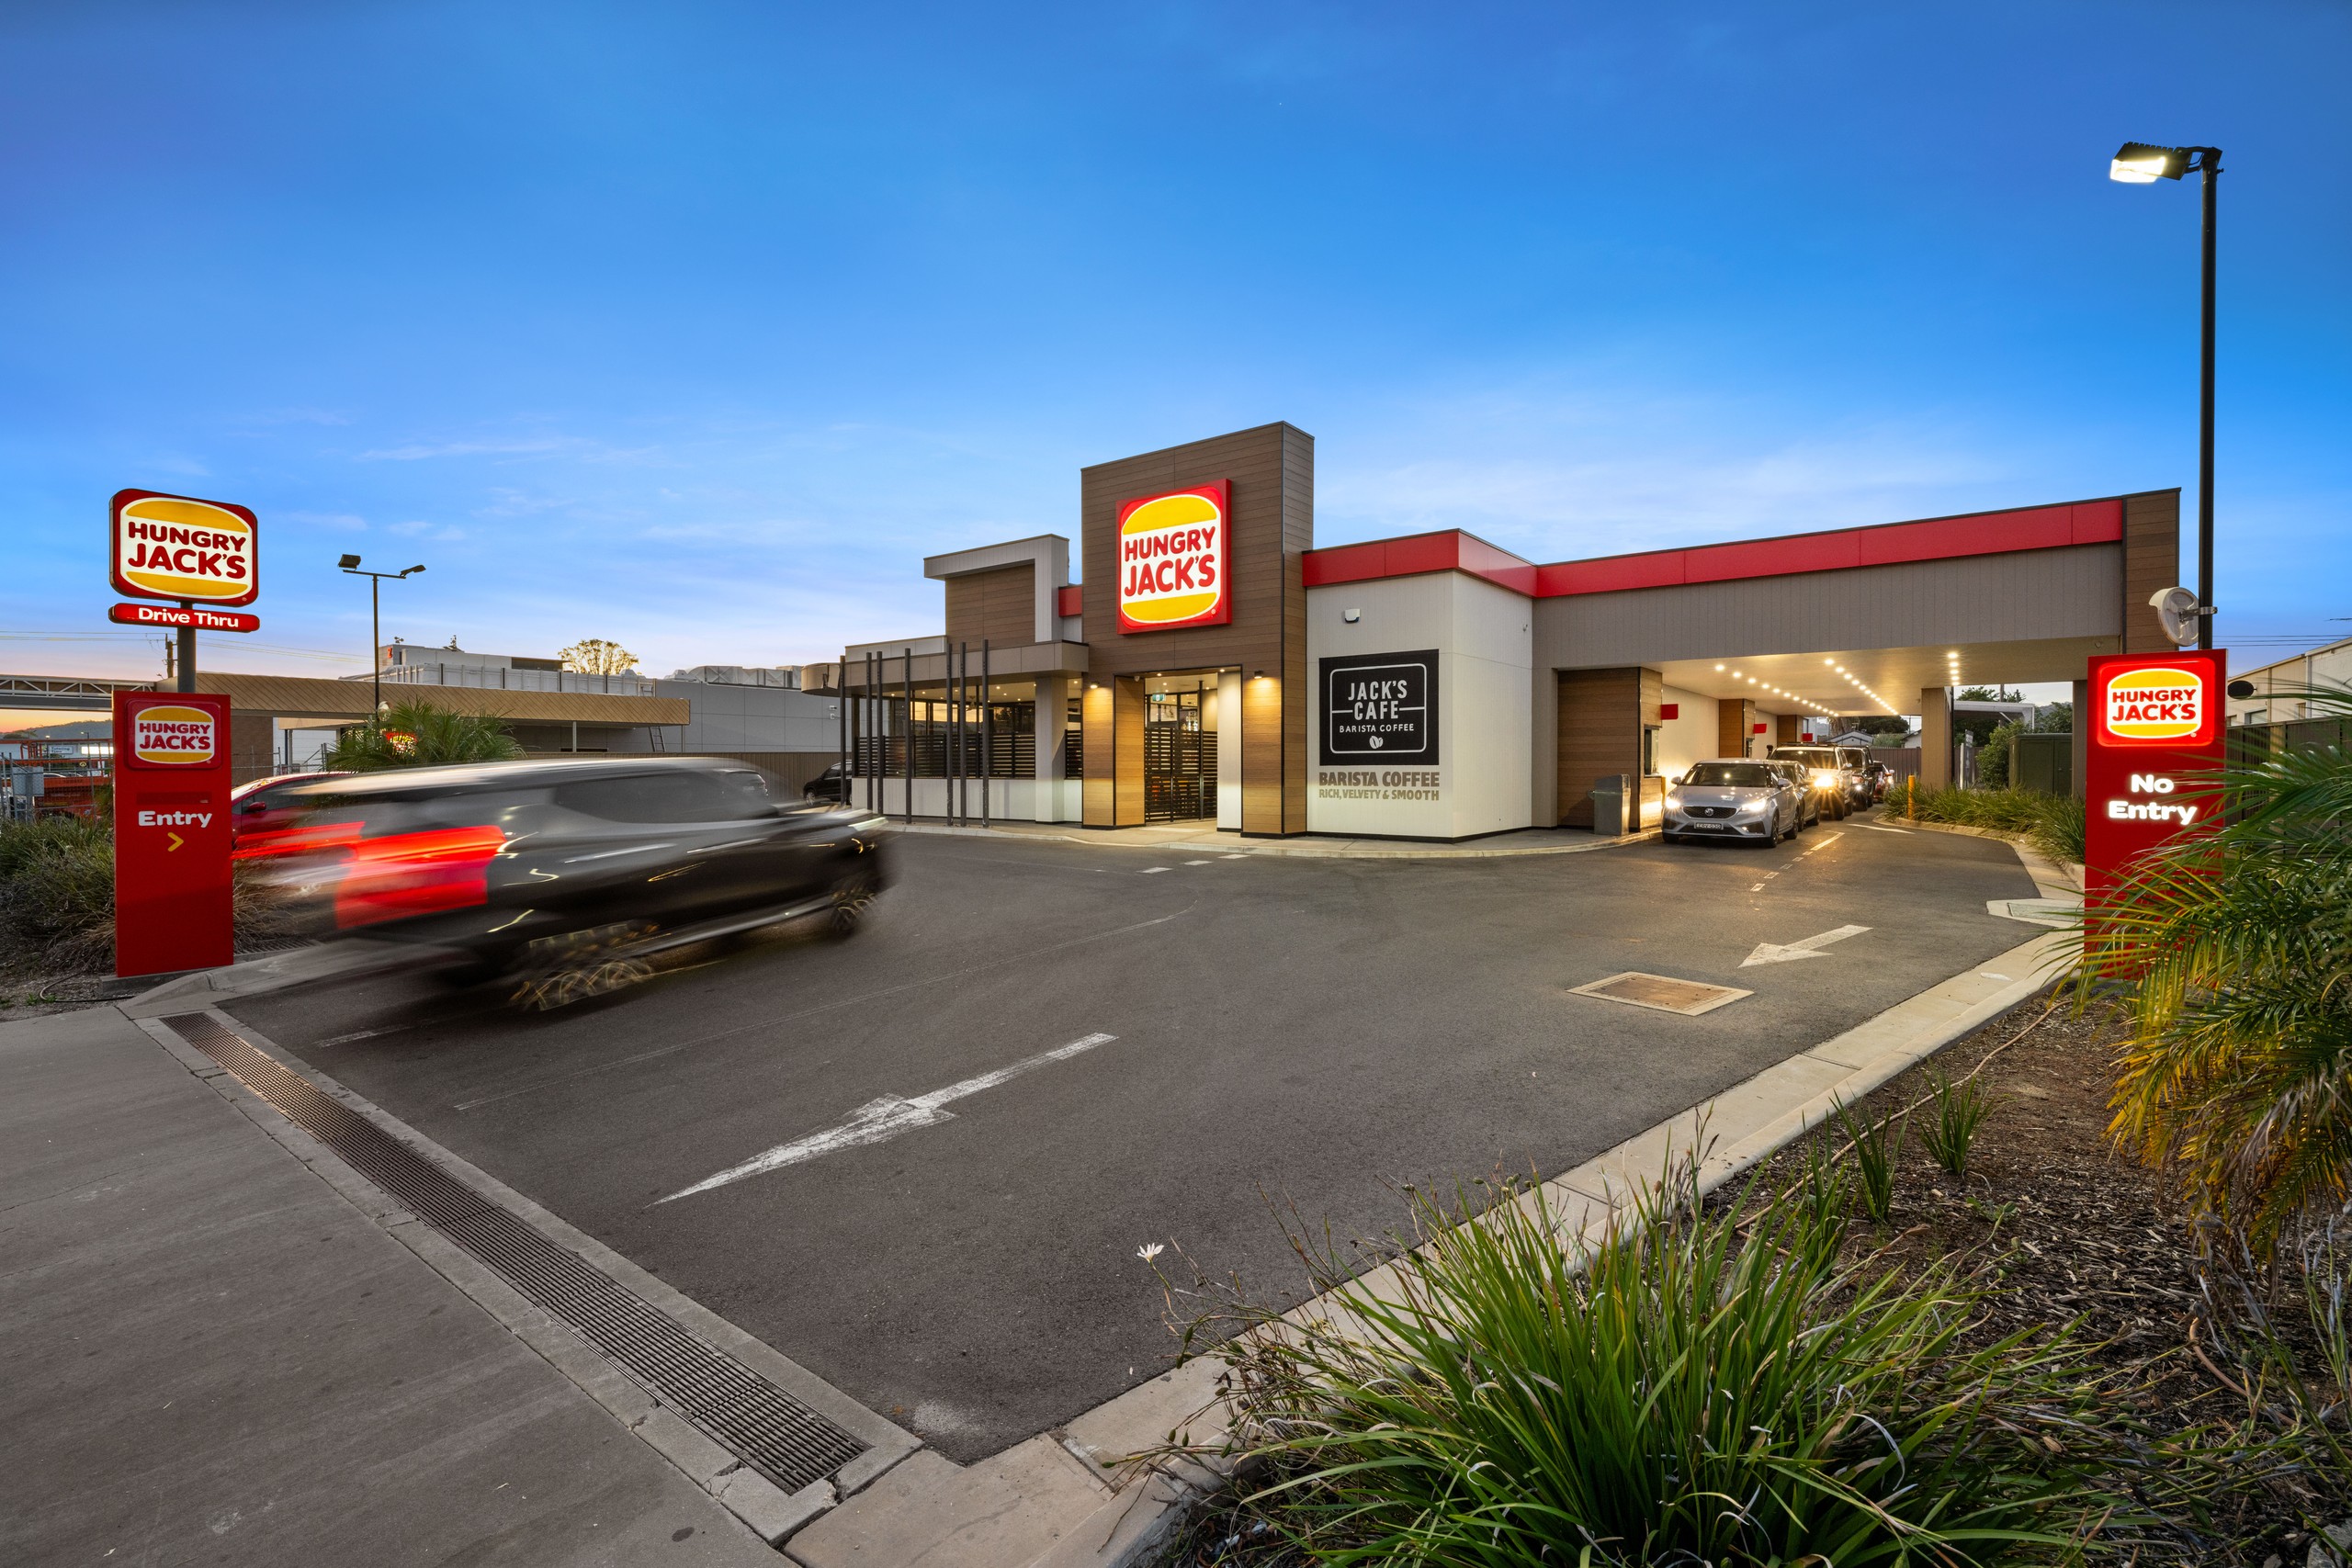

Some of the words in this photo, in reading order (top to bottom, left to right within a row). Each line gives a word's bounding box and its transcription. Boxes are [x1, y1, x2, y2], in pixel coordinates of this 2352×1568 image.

[128, 522, 246, 552] HUNGRY
[1125, 526, 1216, 562] HUNGRY
[128, 543, 246, 579] JACK'S
[1124, 554, 1216, 597] JACK'S
[139, 607, 190, 624] Drive
[194, 612, 239, 627] Thru
[1348, 680, 1408, 701] JACK'S
[2112, 689, 2197, 703] HUNGRY
[1354, 701, 1398, 720] CAFE
[2112, 703, 2197, 721] JACK'S
[139, 723, 210, 734] HUNGRY
[1340, 725, 1376, 733] BARISTA
[1380, 724, 1415, 732] COFFEE
[139, 735, 211, 750] JACK'S
[1319, 772, 1378, 786] BARISTA
[1382, 772, 1440, 787] COFFEE
[2131, 773, 2175, 794] No
[1342, 789, 1381, 799] VELVETY
[1383, 790, 1389, 799] &
[1392, 790, 1440, 801] SMOOTH
[138, 810, 213, 829] Entry
[2108, 800, 2198, 826] Entry
